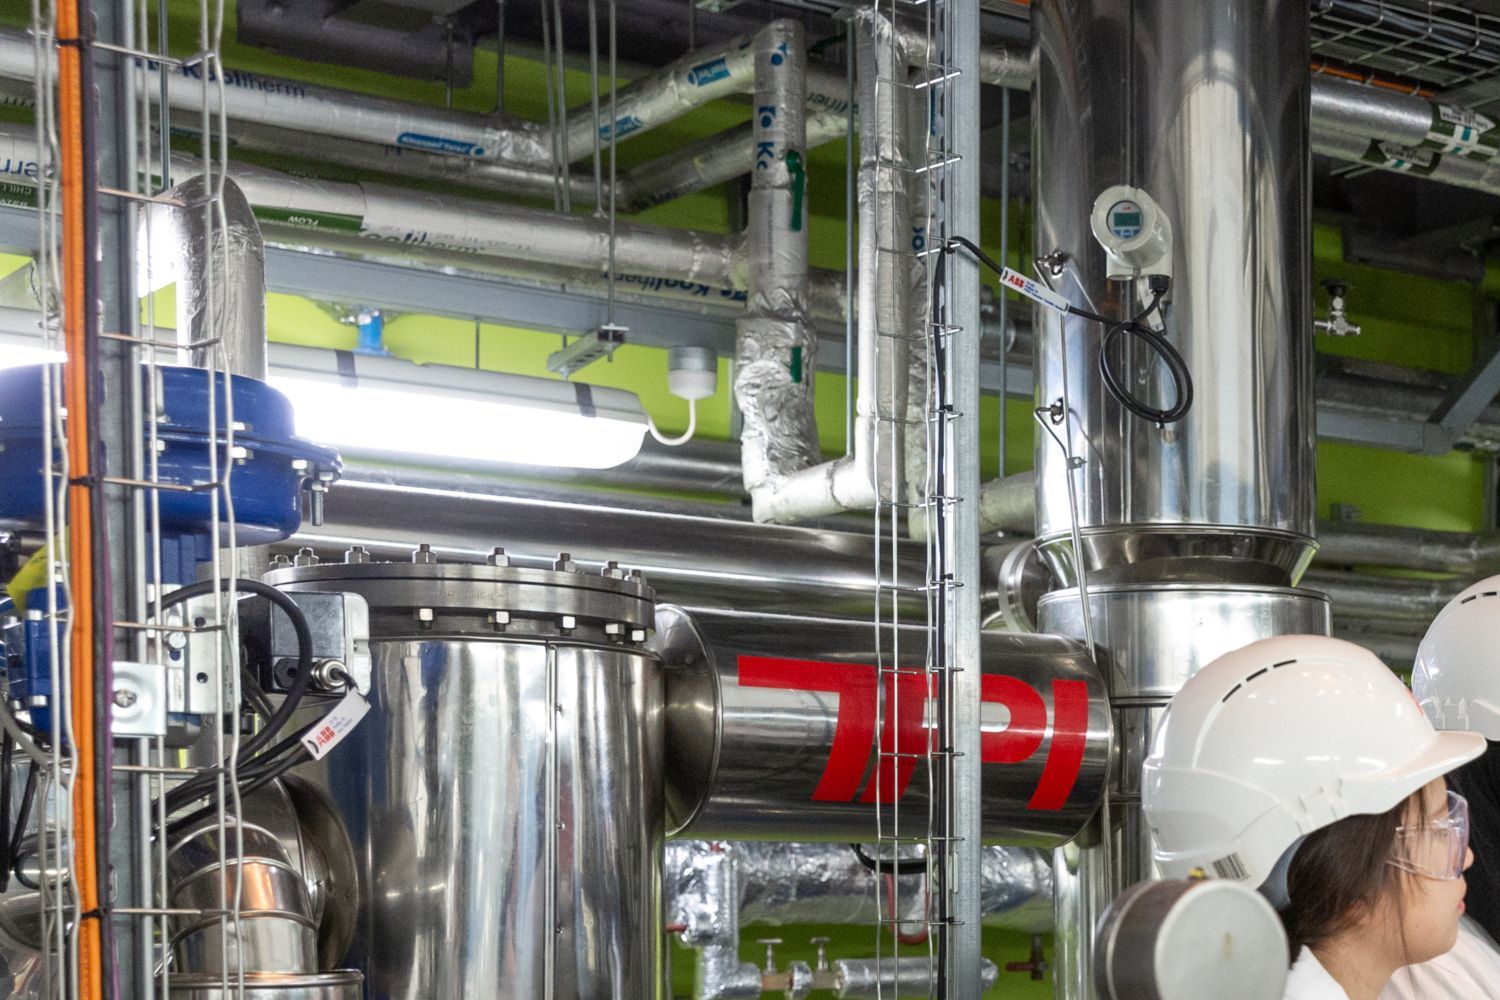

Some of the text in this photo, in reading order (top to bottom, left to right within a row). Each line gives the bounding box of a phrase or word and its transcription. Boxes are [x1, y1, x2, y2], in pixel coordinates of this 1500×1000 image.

[287, 214, 320, 227] FLOW
[1007, 275, 1025, 289] ABB
[315, 726, 336, 748] ABB
